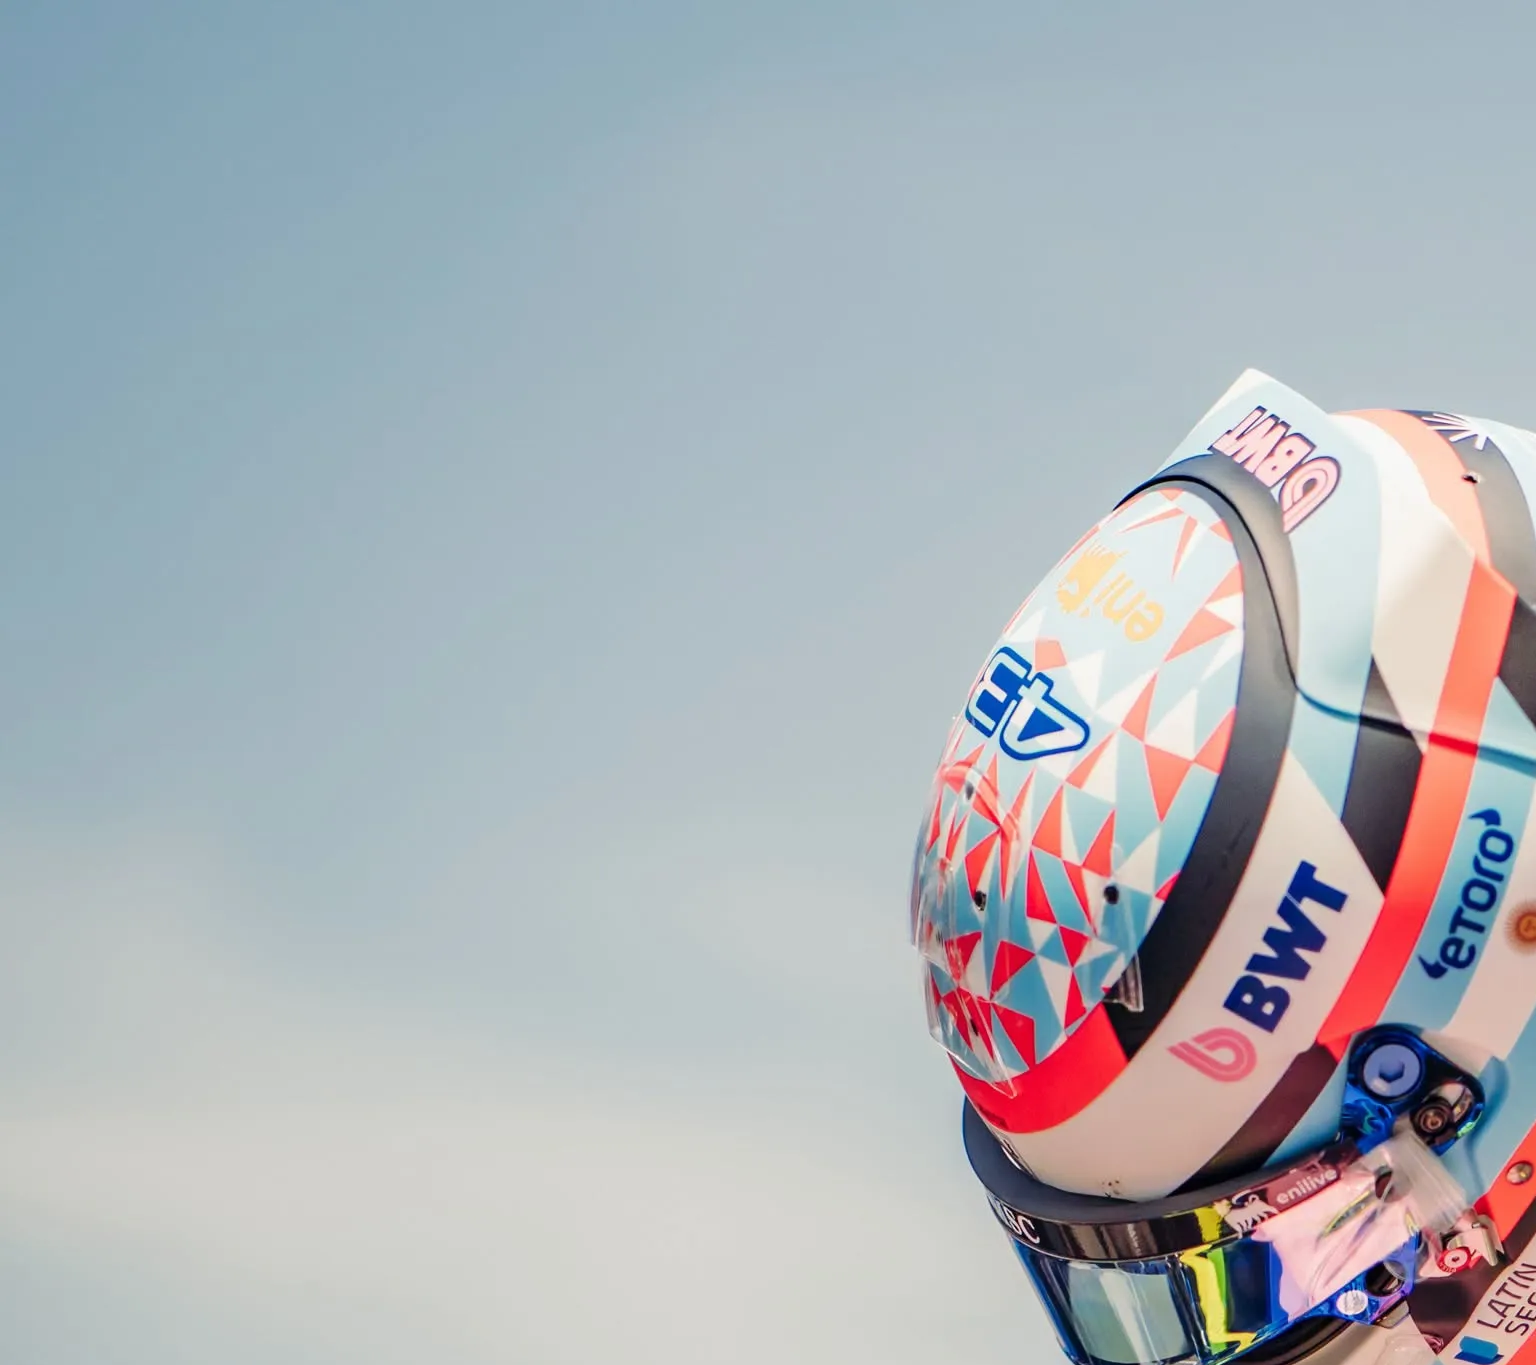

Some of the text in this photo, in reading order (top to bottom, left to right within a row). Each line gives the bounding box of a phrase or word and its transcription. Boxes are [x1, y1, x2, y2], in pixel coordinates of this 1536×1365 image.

[1207, 405, 1317, 488] BWT
[965, 646, 1091, 761] 43
[1222, 860, 1349, 1034] BWT
[1275, 1168, 1338, 1205] enilive
